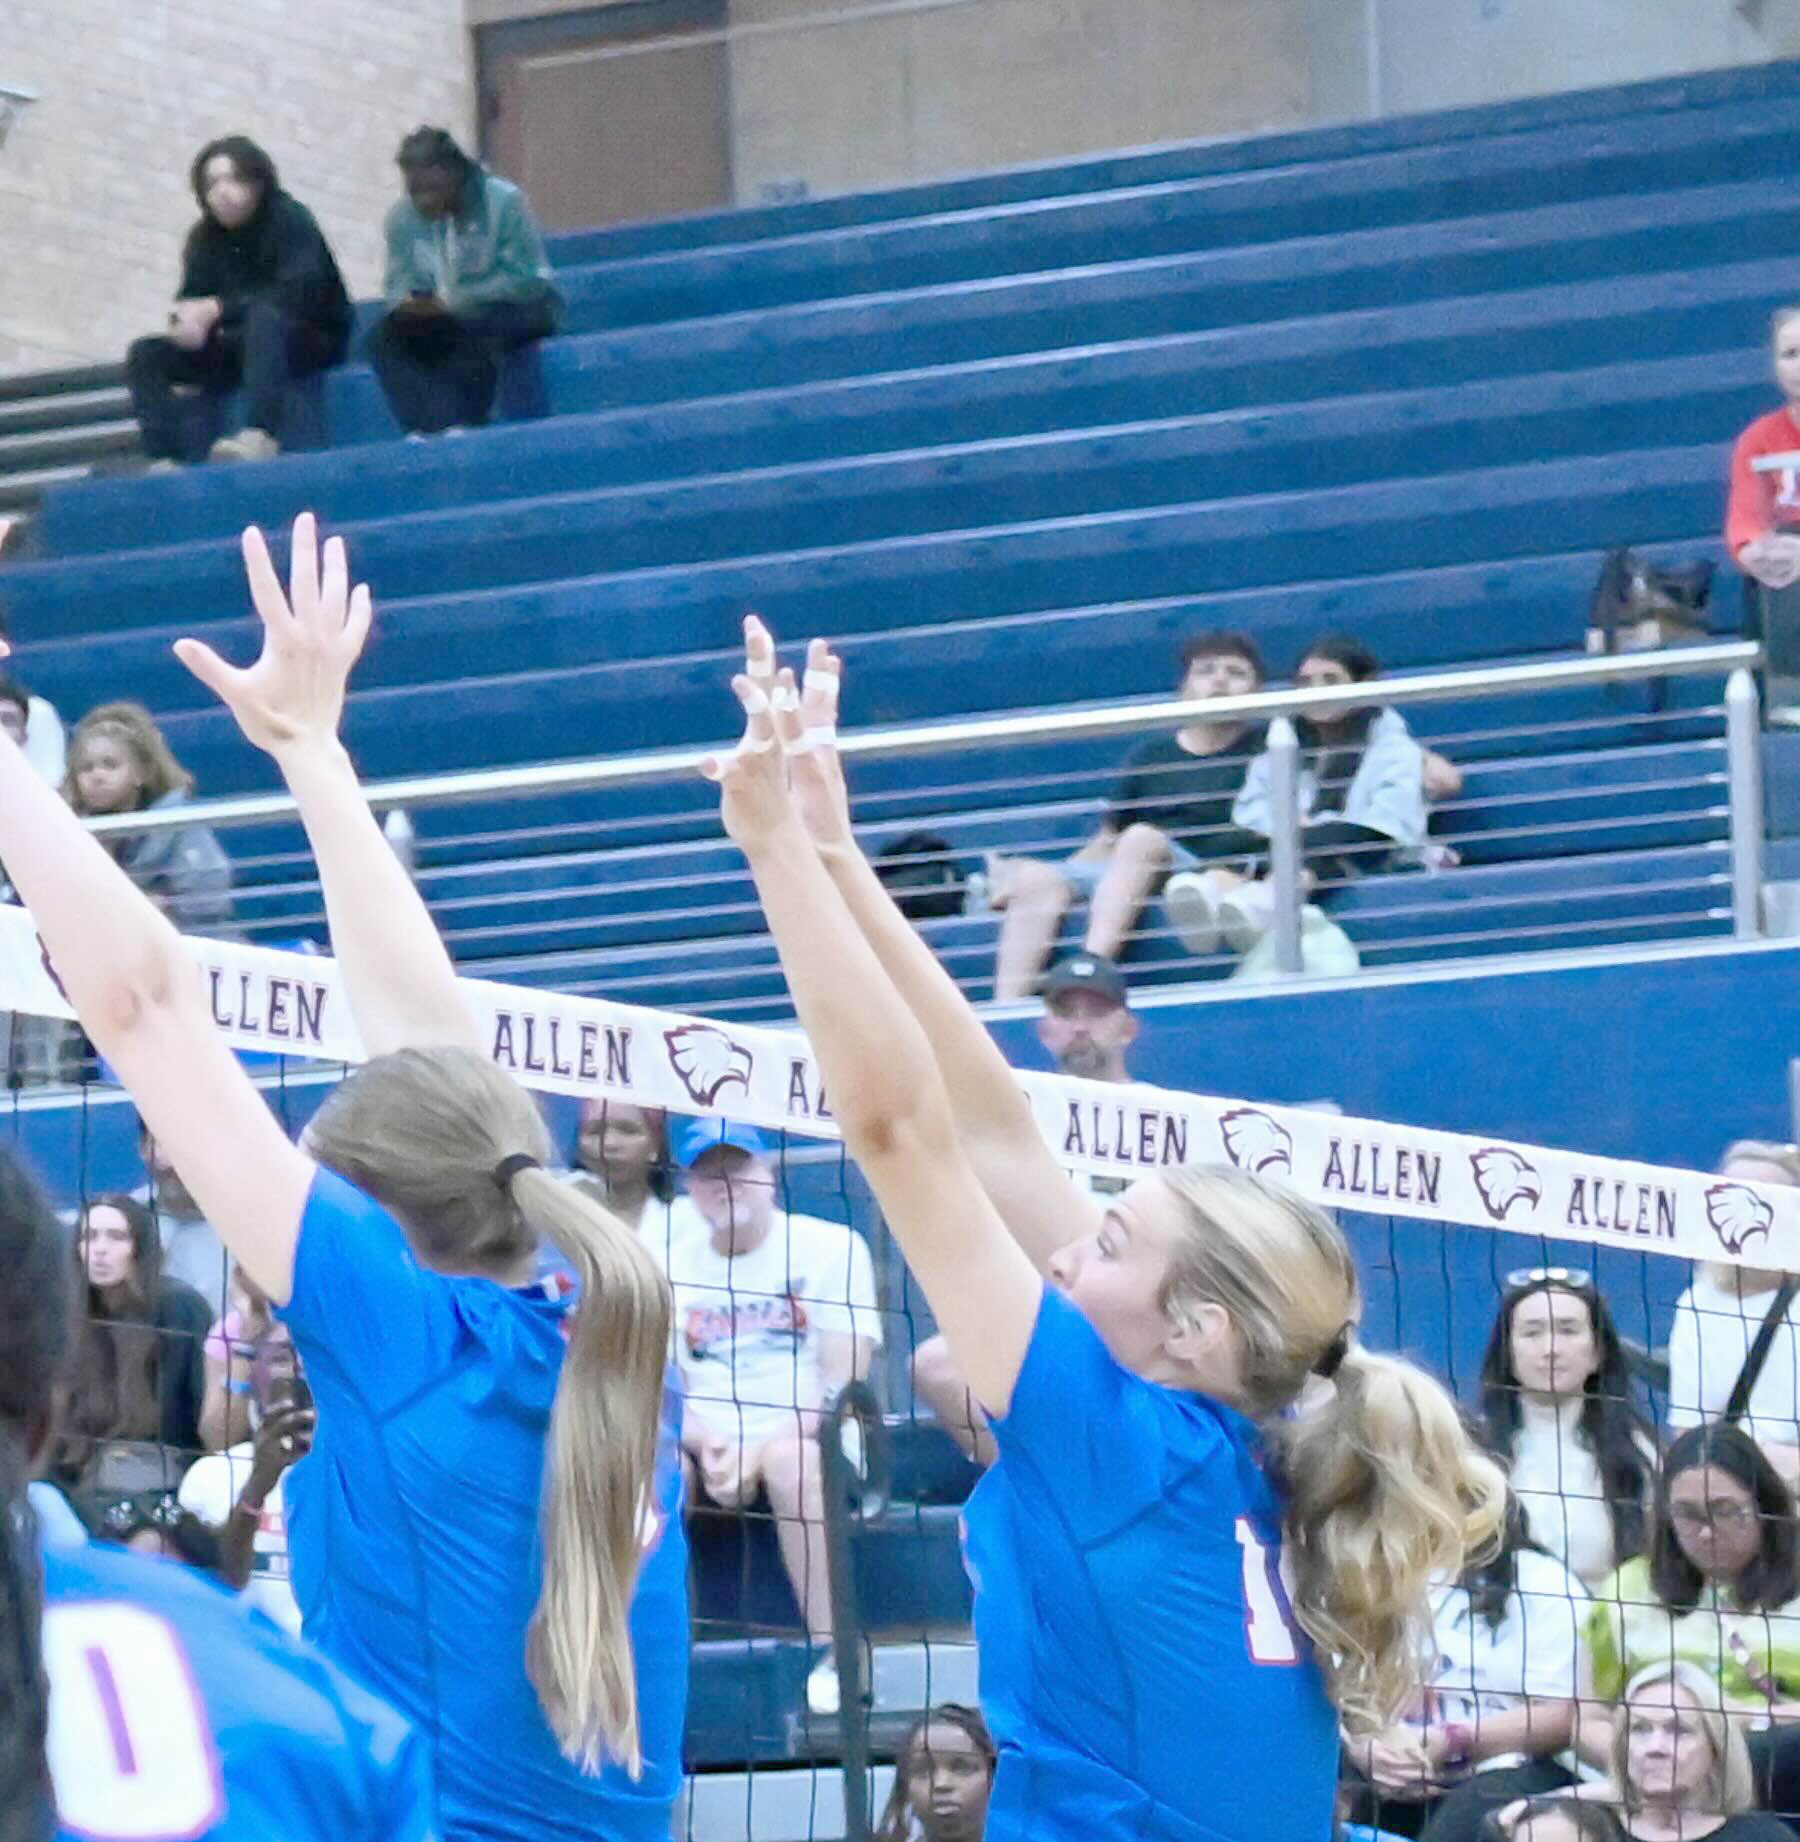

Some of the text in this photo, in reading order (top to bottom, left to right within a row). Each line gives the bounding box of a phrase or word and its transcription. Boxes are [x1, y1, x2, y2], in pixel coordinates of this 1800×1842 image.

[207, 967, 326, 1044] LLEN
[492, 1009, 633, 1086] ALLEN
[1064, 1099, 1188, 1166] ALLEN
[1322, 1136, 1441, 1206] ALLEN
[1566, 1172, 1678, 1241] ALLEN
